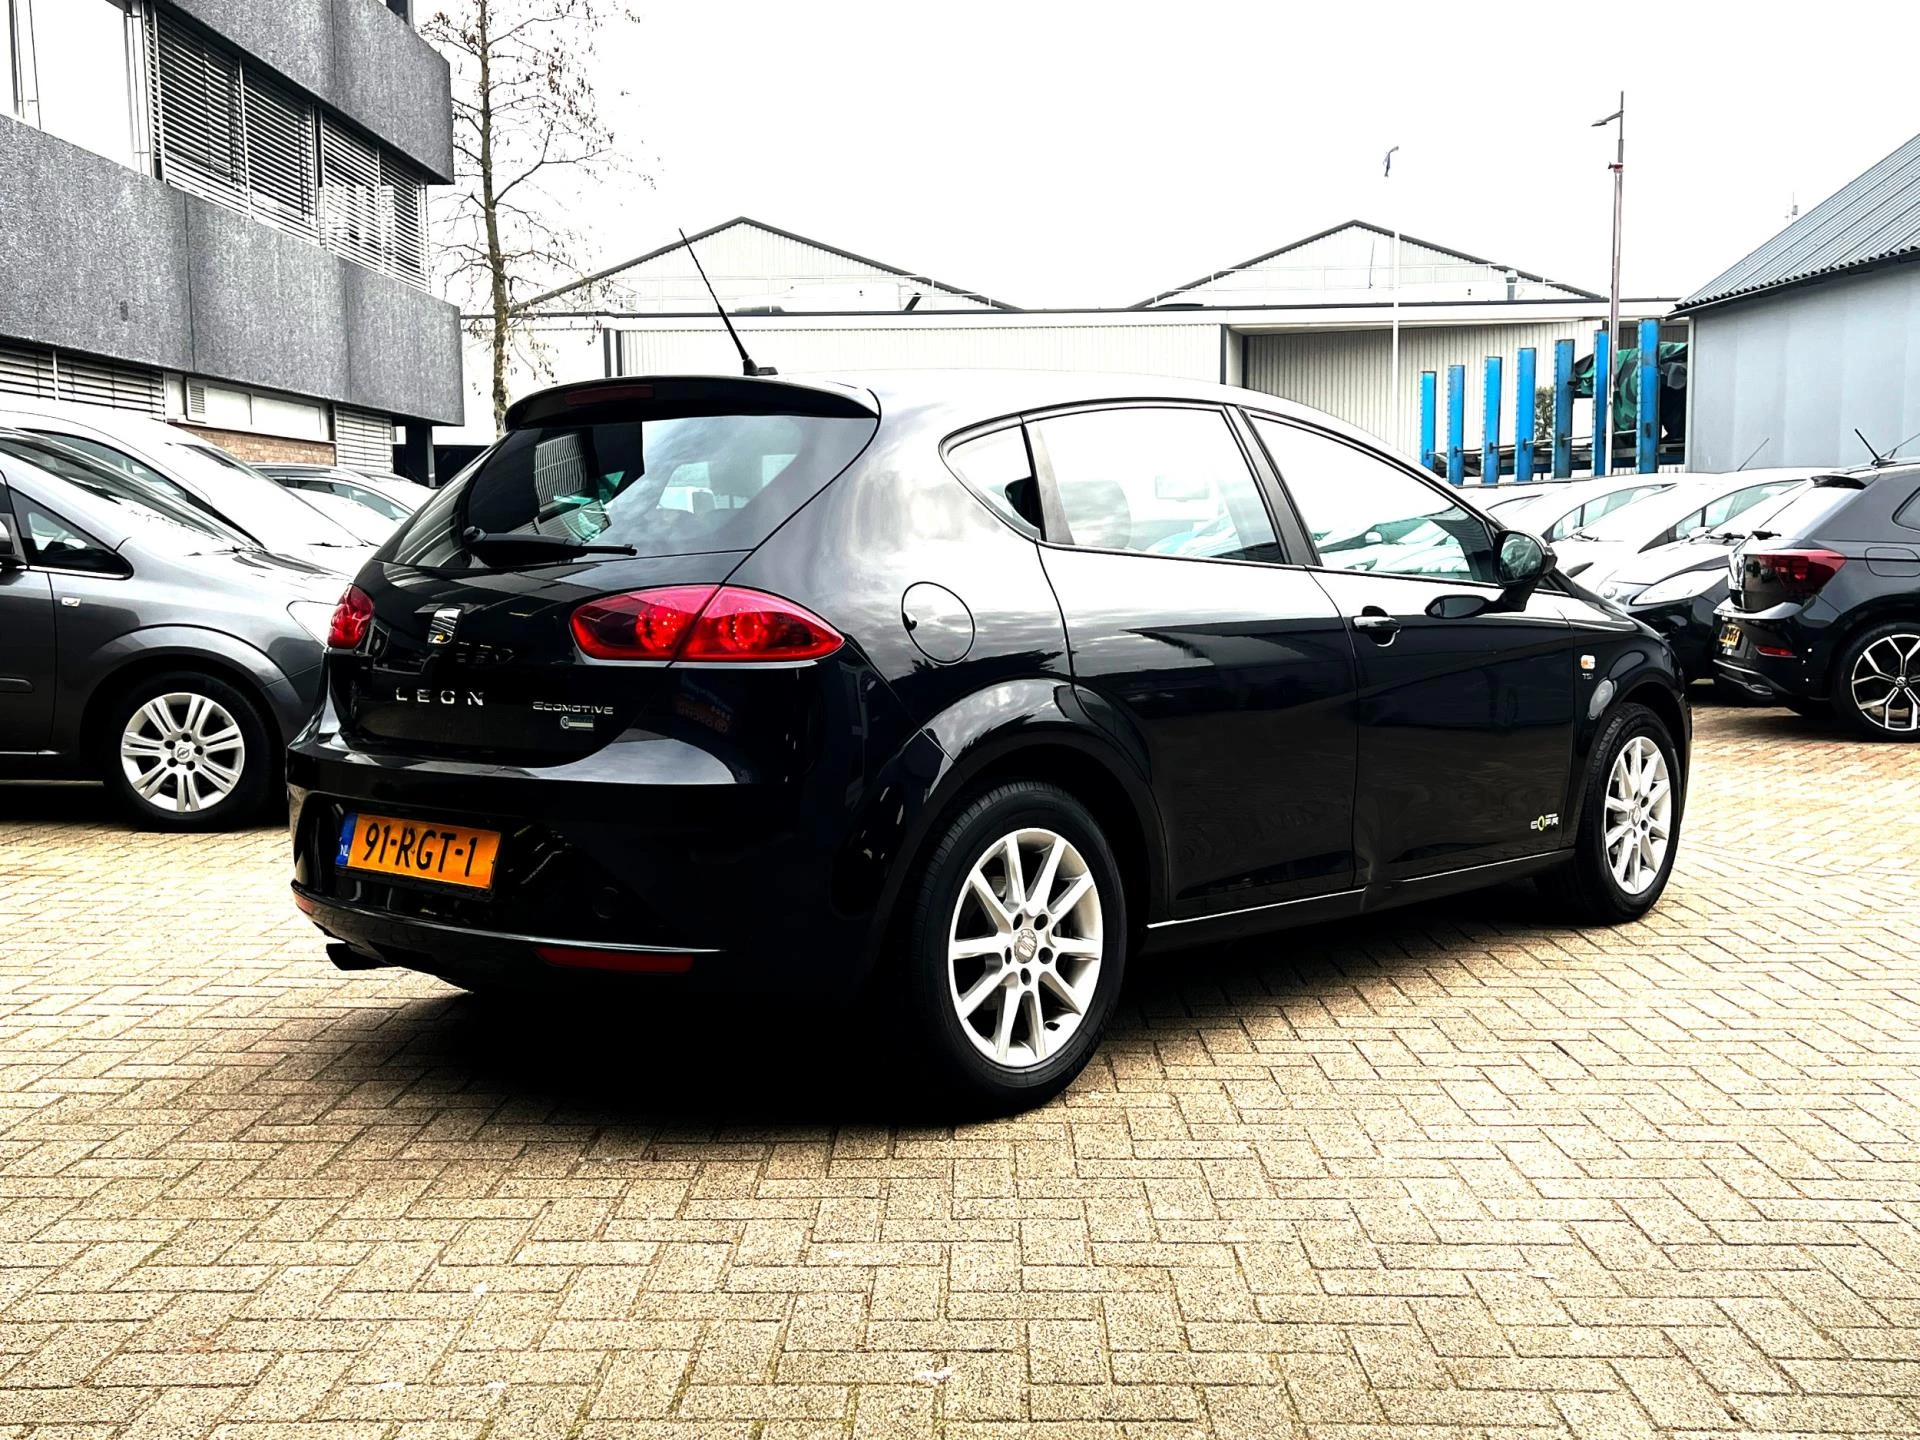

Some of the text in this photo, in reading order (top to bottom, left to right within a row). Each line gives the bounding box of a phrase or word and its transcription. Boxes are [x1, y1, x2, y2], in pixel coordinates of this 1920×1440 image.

[395, 687, 484, 706] LEON
[532, 701, 614, 715] ECOMOTIVE
[363, 822, 478, 877] 91-RGT-1
